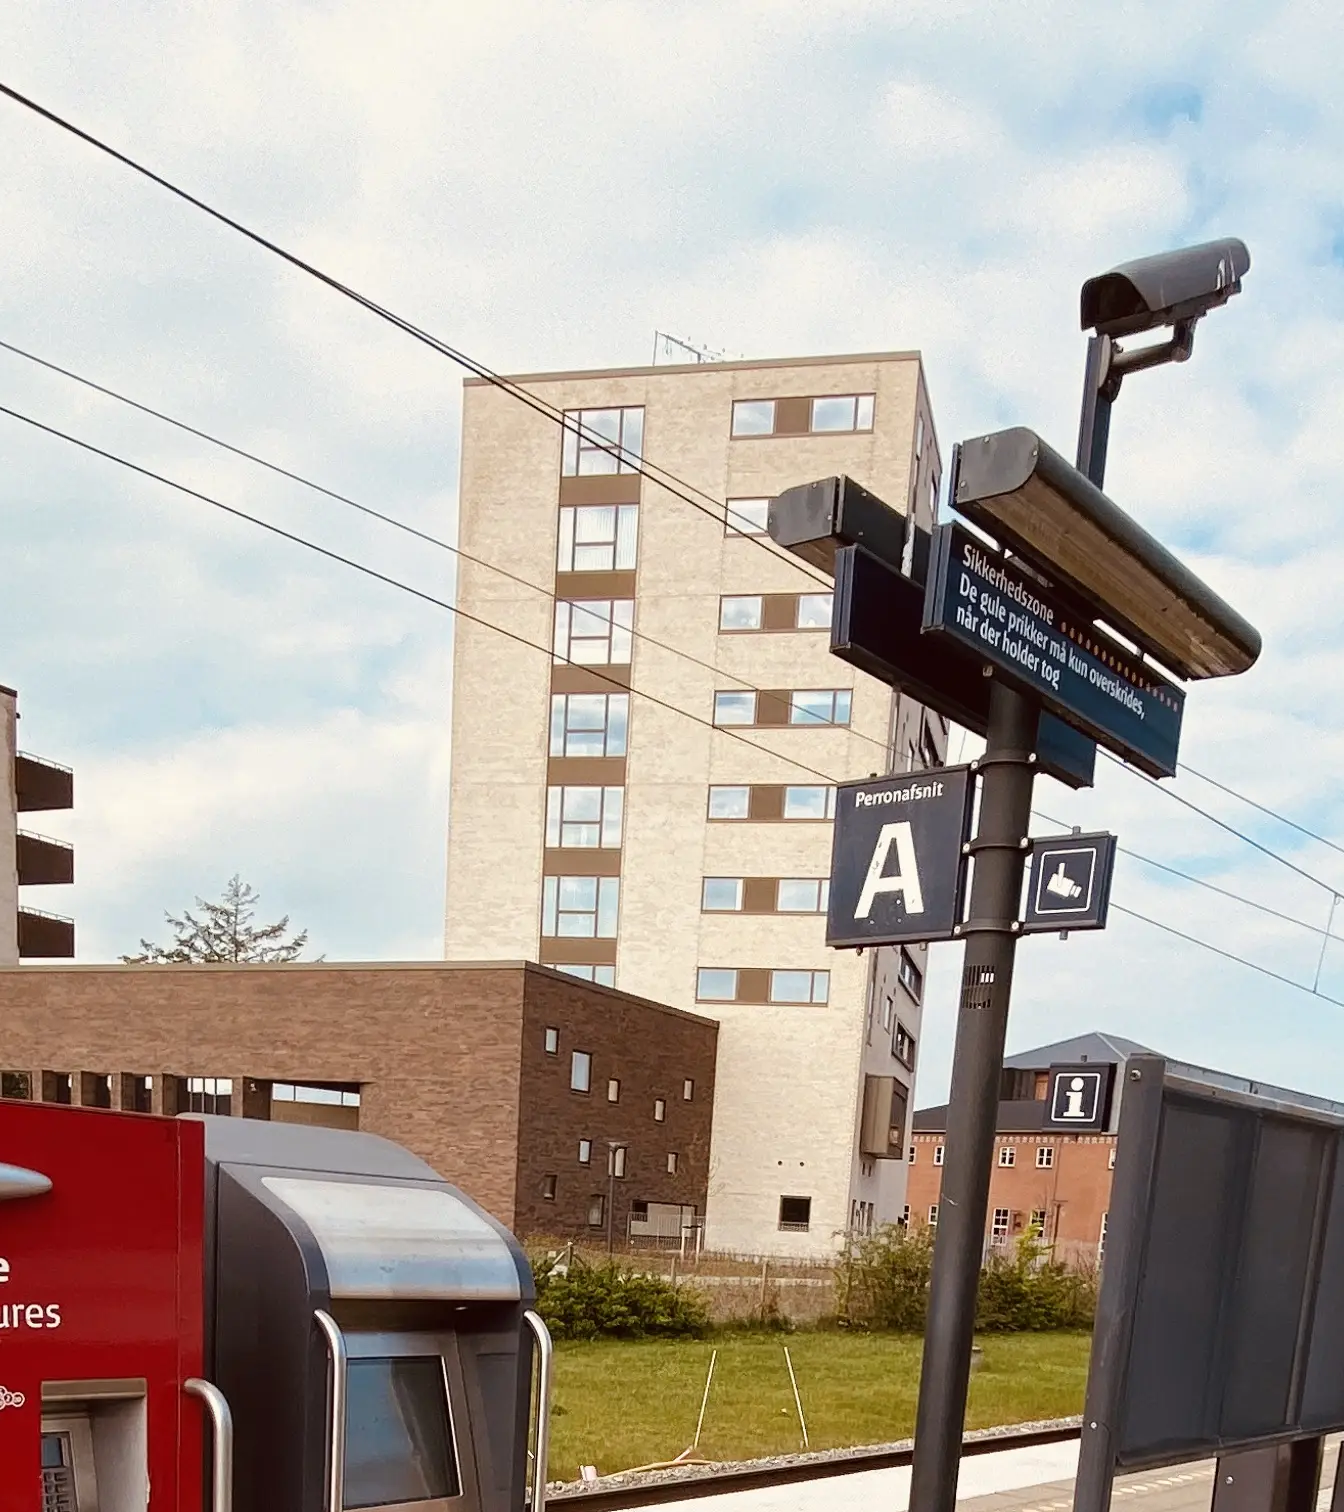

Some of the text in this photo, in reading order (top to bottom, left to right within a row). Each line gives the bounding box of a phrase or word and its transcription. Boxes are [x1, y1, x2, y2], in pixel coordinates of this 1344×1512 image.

[962, 544, 1054, 625] Sikkerhedszone
[956, 605, 1060, 690] når der holder tog
[960, 573, 1145, 720] De gule prikker må kun overskrides,
[855, 782, 944, 807] Perronafsnit
[854, 821, 924, 919] A
